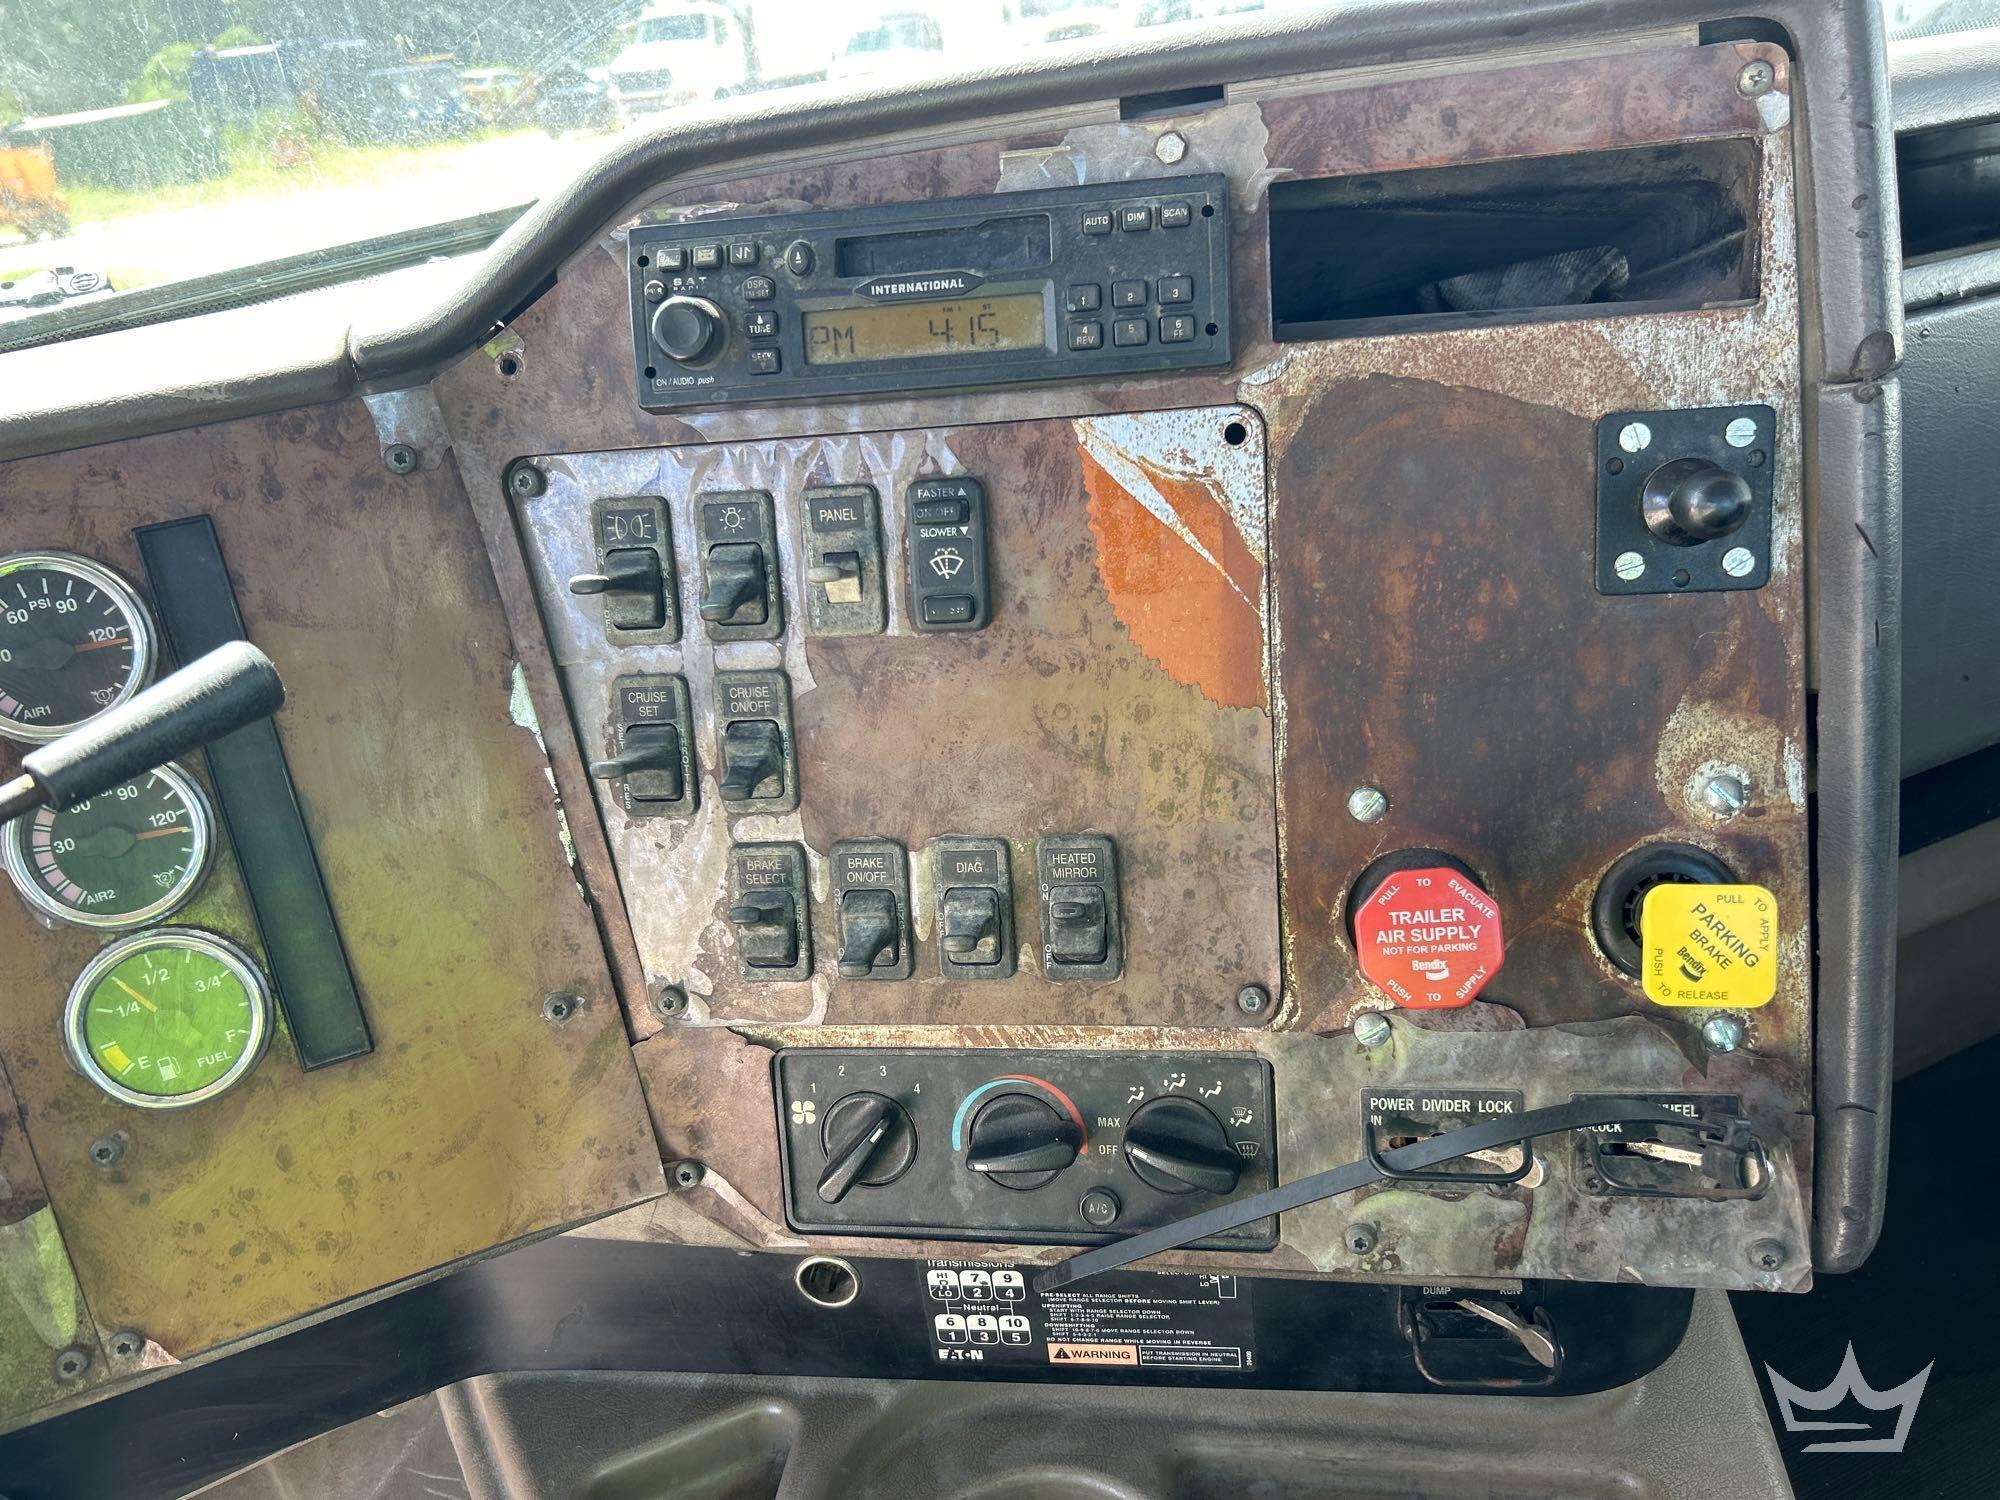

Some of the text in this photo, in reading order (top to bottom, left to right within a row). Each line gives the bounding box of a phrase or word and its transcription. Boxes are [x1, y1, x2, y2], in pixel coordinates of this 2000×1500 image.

[1127, 212, 1145, 222] DIM
[1163, 208, 1188, 218] SCAN
[1085, 216, 1109, 226] AUTO
[870, 278, 965, 296] INTERNATIONAL
[1127, 293, 1134, 301] 2
[1172, 289, 1179, 298] 3
[1081, 296, 1086, 306] 1
[749, 324, 772, 334] TUNE
[1128, 324, 1135, 333] 5
[1175, 319, 1182, 328] 6
[1082, 326, 1088, 334] 4
[1076, 336, 1095, 344] REV
[697, 376, 715, 386] push
[917, 487, 955, 499] FASTER
[819, 508, 858, 522] PANEL
[920, 527, 957, 538] SLOWER
[28, 597, 51, 611] PSI
[6, 598, 117, 643] 60 90 120
[628, 691, 667, 704] CRUISE
[729, 686, 769, 699] CRUISE
[23, 704, 52, 721] AIR1
[639, 706, 659, 717] SET
[730, 701, 771, 713] ON/OFF
[617, 724, 625, 750] SET
[623, 783, 632, 810] RES
[117, 785, 139, 800] 90
[149, 810, 177, 827] 120
[53, 838, 75, 854] 30
[847, 857, 883, 869] BRAKE
[1052, 853, 1096, 865] HEATED
[746, 860, 782, 871] BRAKE
[956, 861, 983, 873] DIAG
[745, 873, 787, 885] SELECT
[846, 871, 887, 883] ON/OFF
[1052, 867, 1097, 879] MIRROR
[87, 889, 117, 905] AIR2
[1041, 883, 1049, 901] ON
[1378, 884, 1400, 906] PULL
[1447, 879, 1496, 919] EVACUATE
[1388, 908, 1466, 925] TRAILER
[1716, 894, 1769, 952] PULL TO APPLY
[1376, 925, 1482, 944] AIR SUPPLY
[1691, 903, 1759, 968] PARKING
[1382, 942, 1478, 955] NOT FOR PARKING
[1689, 928, 1733, 970] BRAKE
[1044, 944, 1052, 971] OFF
[1677, 946, 1707, 976] Bendix
[1412, 959, 1449, 971] Bendix
[142, 968, 170, 986] 1/2
[1654, 948, 1729, 1000] PUSH TO RELEASE
[195, 976, 221, 993] 3/4
[1386, 965, 1487, 1001] PUSH TO SUPPLY
[116, 1000, 141, 1017] 1/4
[225, 1029, 236, 1043] F
[138, 1055, 151, 1070] E
[197, 1050, 233, 1068] FUEL
[838, 1065, 845, 1076] 2
[880, 1065, 887, 1076] 3
[810, 1083, 816, 1093] 1
[913, 1083, 921, 1094] 4
[1370, 1097, 1513, 1113] POWER DIVIDER LOCK
[1097, 1117, 1121, 1128] MAX
[1370, 1115, 1382, 1126] IN
[1098, 1144, 1118, 1155] OFF
[1089, 1203, 1108, 1214] A/C
[970, 1273, 980, 1282] 7
[1003, 1274, 1012, 1283] 9
[973, 1288, 982, 1298] 2
[1005, 1289, 1014, 1298] 4
[1423, 1286, 1451, 1295] DUMP
[946, 1317, 955, 1326] 6
[978, 1317, 987, 1327] 8
[1006, 1319, 1022, 1328] 10
[948, 1331, 956, 1341] 1
[980, 1332, 989, 1341] 3
[1011, 1332, 1021, 1342] 5
[938, 1348, 984, 1360] EATON
[1071, 1348, 1131, 1360] WARNING
